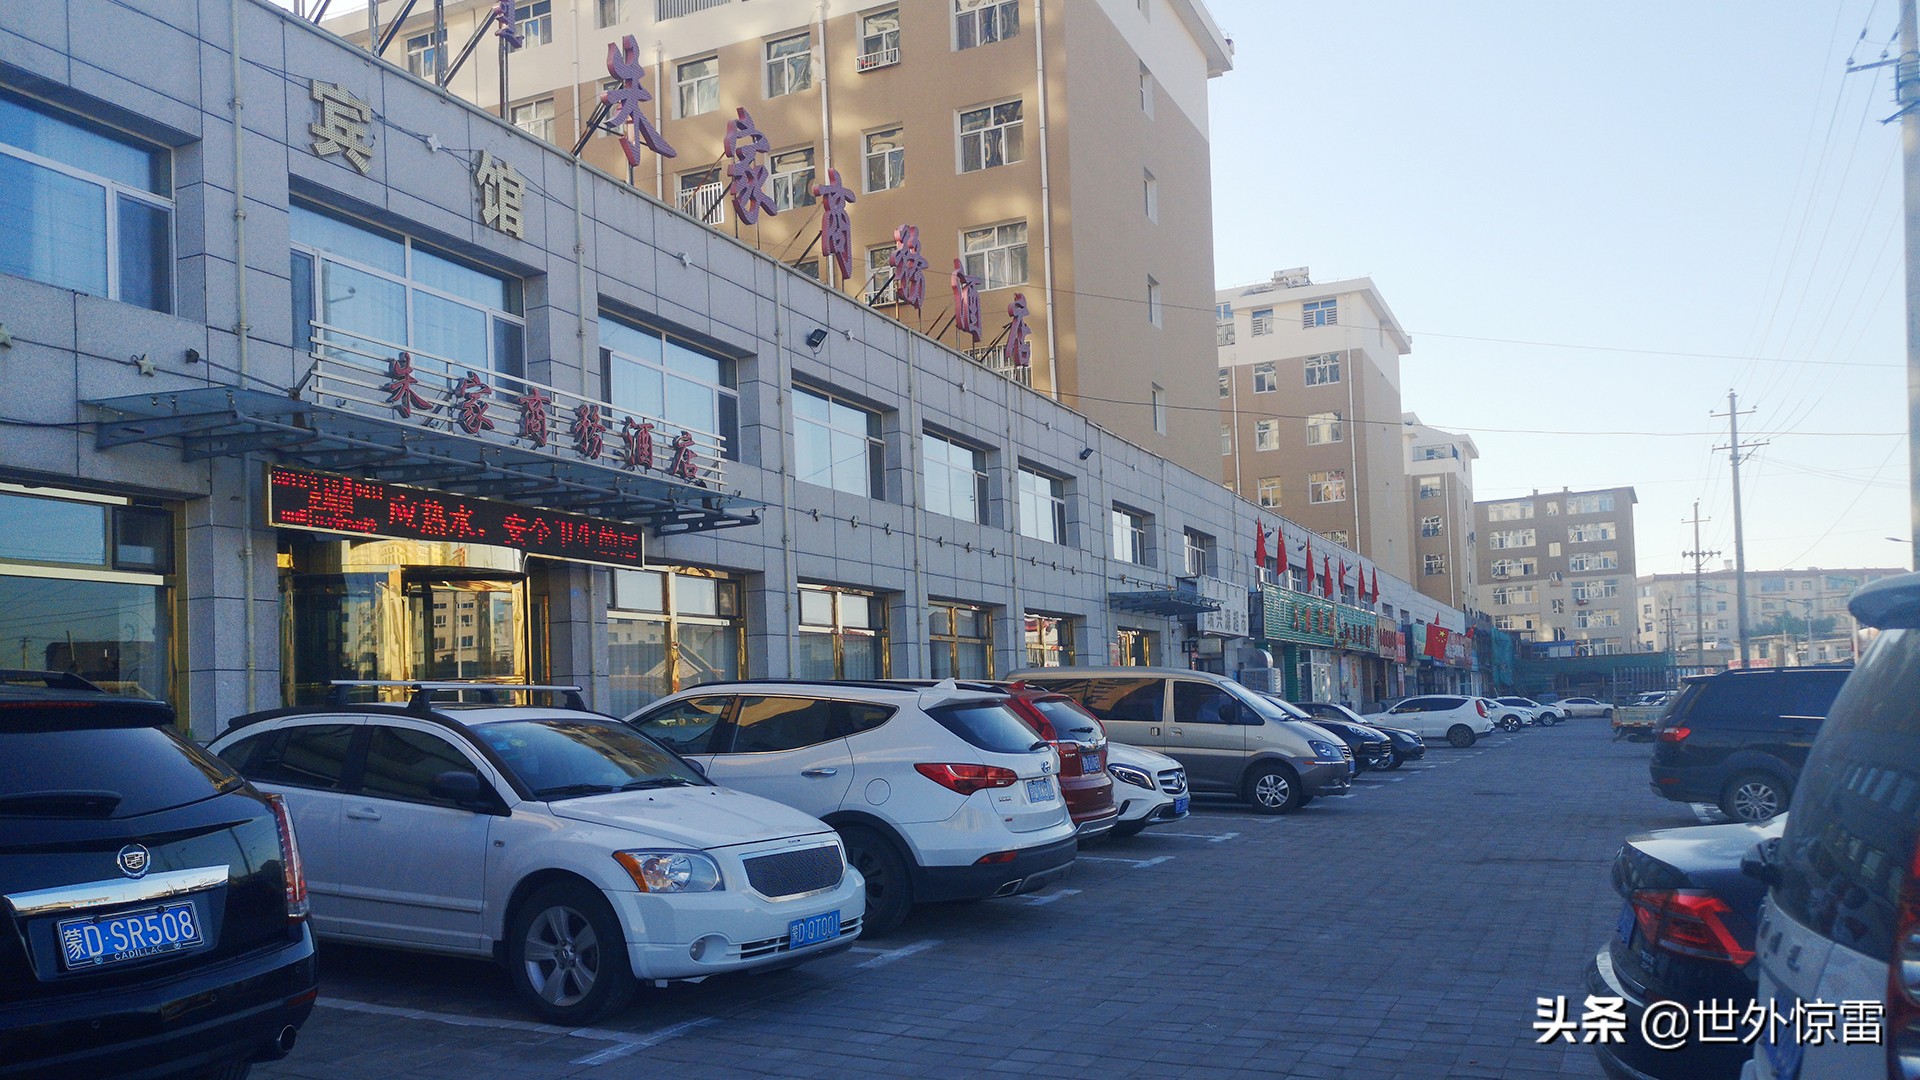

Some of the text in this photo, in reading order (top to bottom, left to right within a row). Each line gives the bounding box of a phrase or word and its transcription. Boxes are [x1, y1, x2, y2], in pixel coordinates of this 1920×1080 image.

[309, 79, 526, 239] 宾馆
[64, 910, 195, 960] 蒙D·SR508
[113, 945, 164, 961] CADILLAC
